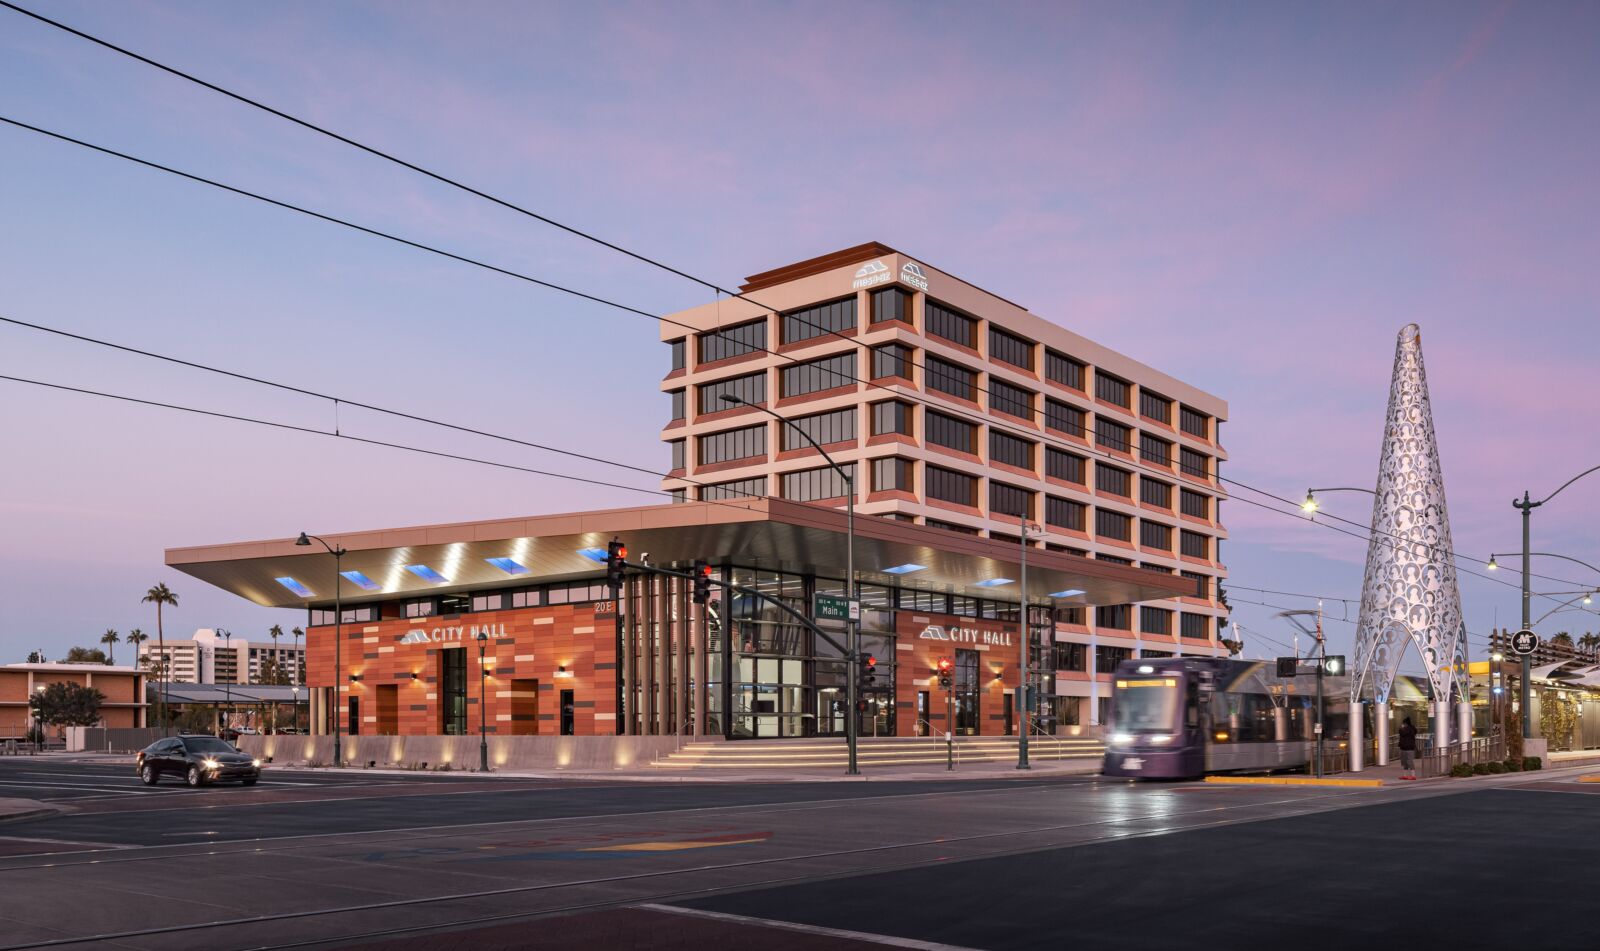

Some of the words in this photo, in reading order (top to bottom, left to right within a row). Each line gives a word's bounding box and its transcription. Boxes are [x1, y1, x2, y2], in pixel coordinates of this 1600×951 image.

[595, 602, 605, 612] 20
[606, 601, 611, 611] E
[822, 605, 838, 616] Main
[431, 625, 463, 641] CITY
[470, 623, 508, 640] HALL
[950, 626, 978, 643] CITY
[983, 630, 1012, 646] HALL
